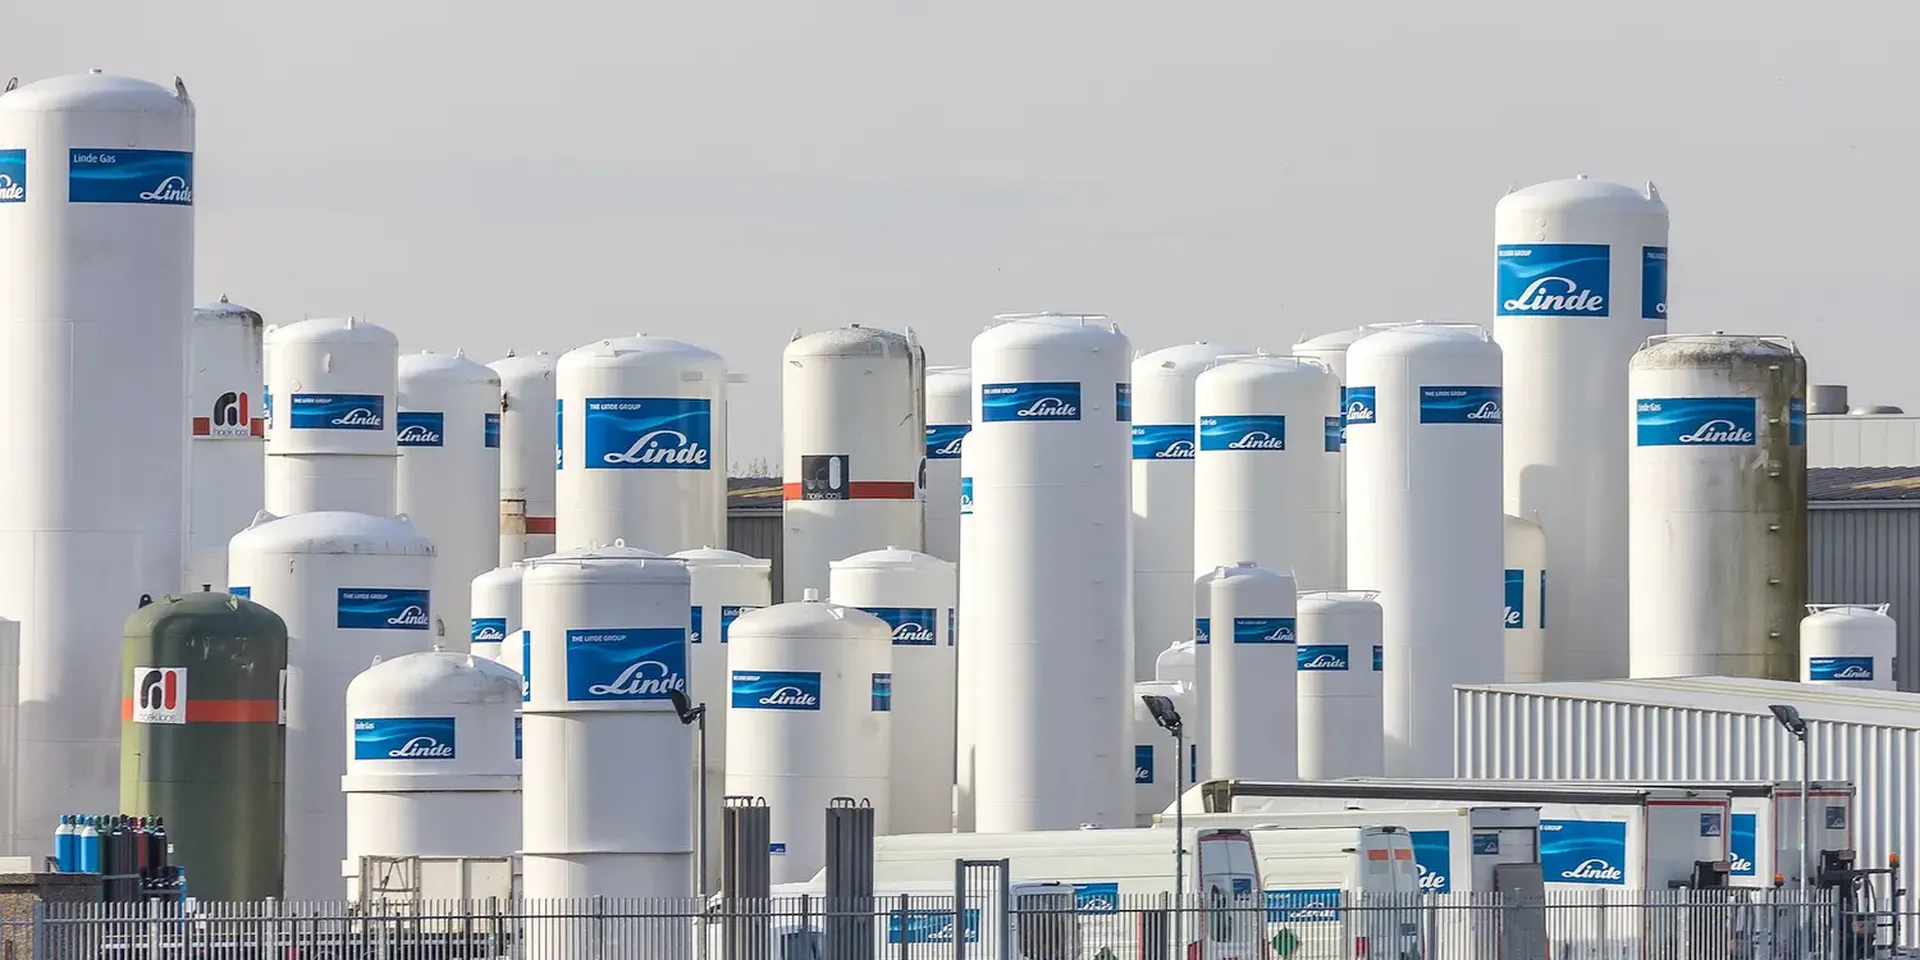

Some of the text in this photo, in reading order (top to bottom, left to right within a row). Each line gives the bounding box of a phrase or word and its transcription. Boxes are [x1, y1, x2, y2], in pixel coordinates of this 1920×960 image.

[74, 154, 116, 163] Linde Gas
[0, 174, 23, 199] nde
[1504, 276, 1603, 311] Linde
[1017, 397, 1077, 417] Linde
[1347, 401, 1373, 420] Linde
[332, 408, 382, 426] Linde
[397, 425, 440, 443] Linde
[1229, 431, 1282, 449] Linde
[1679, 419, 1752, 442] Linde
[604, 430, 708, 464] Linde
[388, 605, 428, 625] Linde
[475, 627, 504, 640] Linde
[603, 634, 627, 642] GROUP
[1304, 654, 1345, 668] Linde
[589, 660, 685, 695] Linde
[1833, 665, 1871, 679] Linde
[759, 686, 816, 705] Linde
[388, 736, 451, 757] Linde
[1561, 858, 1621, 880] Linde
